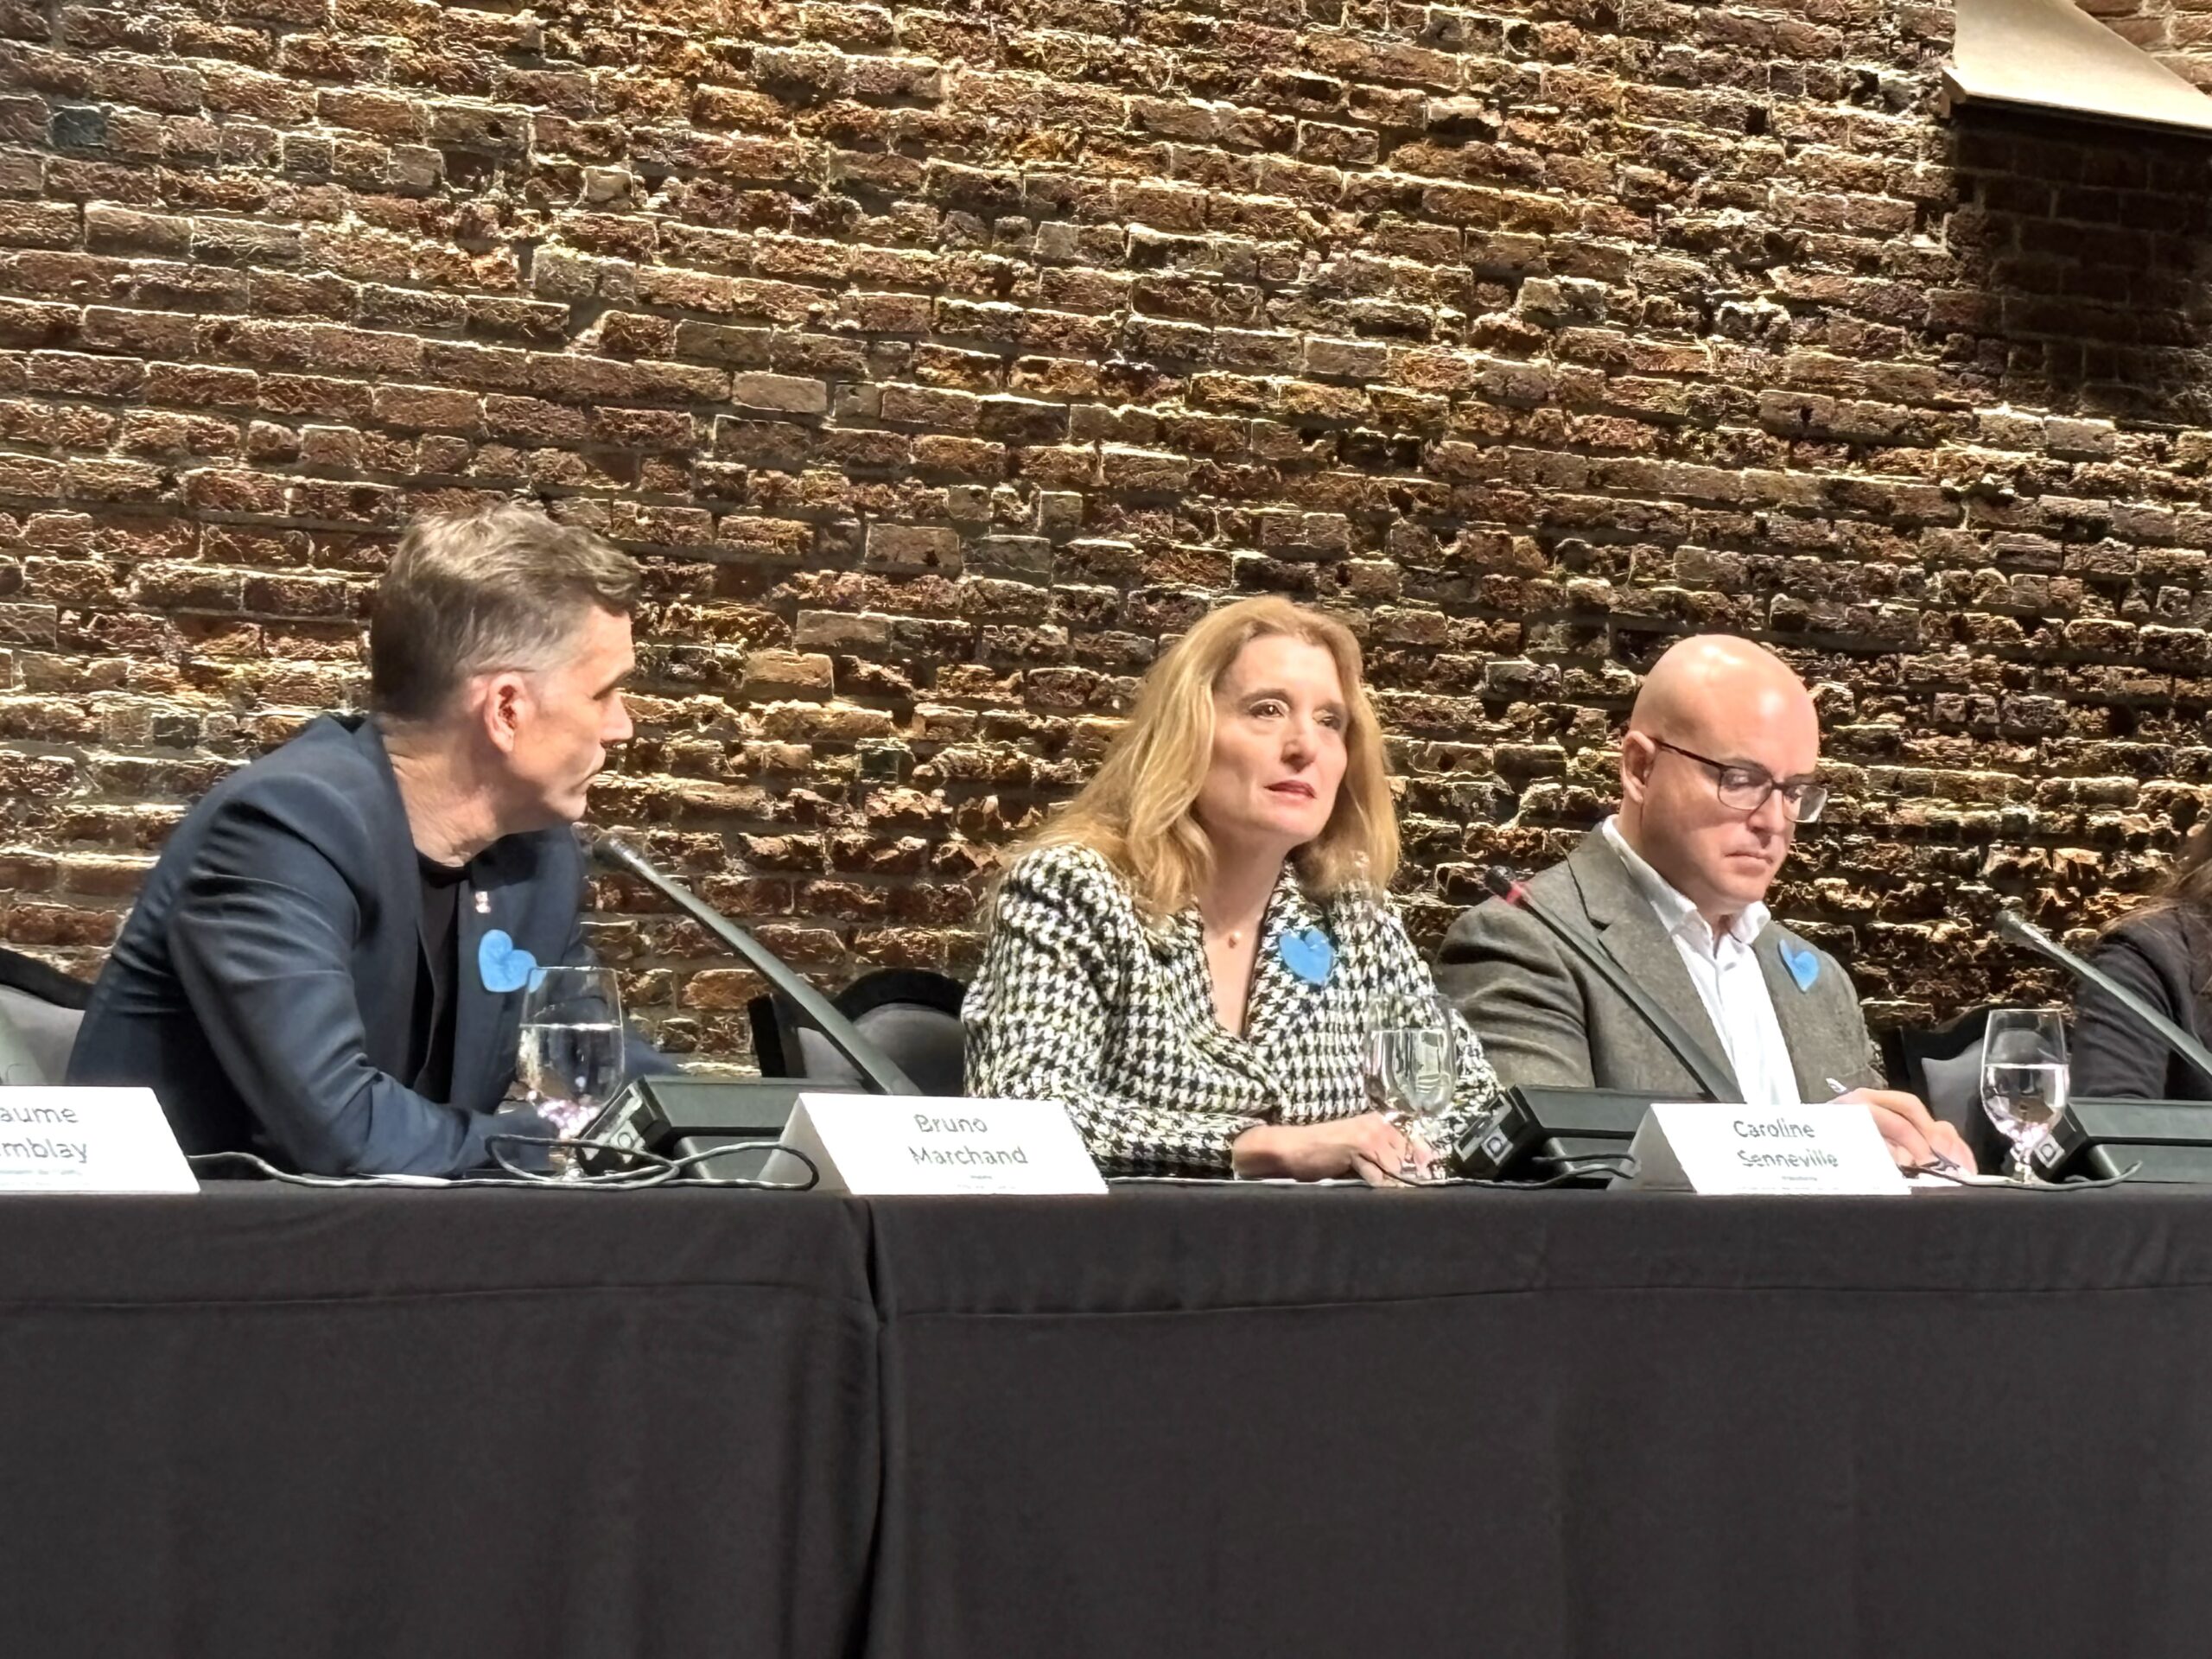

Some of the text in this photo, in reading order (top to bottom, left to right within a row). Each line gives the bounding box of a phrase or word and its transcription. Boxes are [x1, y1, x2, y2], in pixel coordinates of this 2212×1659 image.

[0, 1107, 79, 1123] aume
[913, 1114, 988, 1133] Bruno
[1733, 1117, 1815, 1138] Caroline
[0, 1137, 87, 1164] mblay
[908, 1146, 1028, 1165] Marchand
[1737, 1147, 1839, 1167] Senneville
